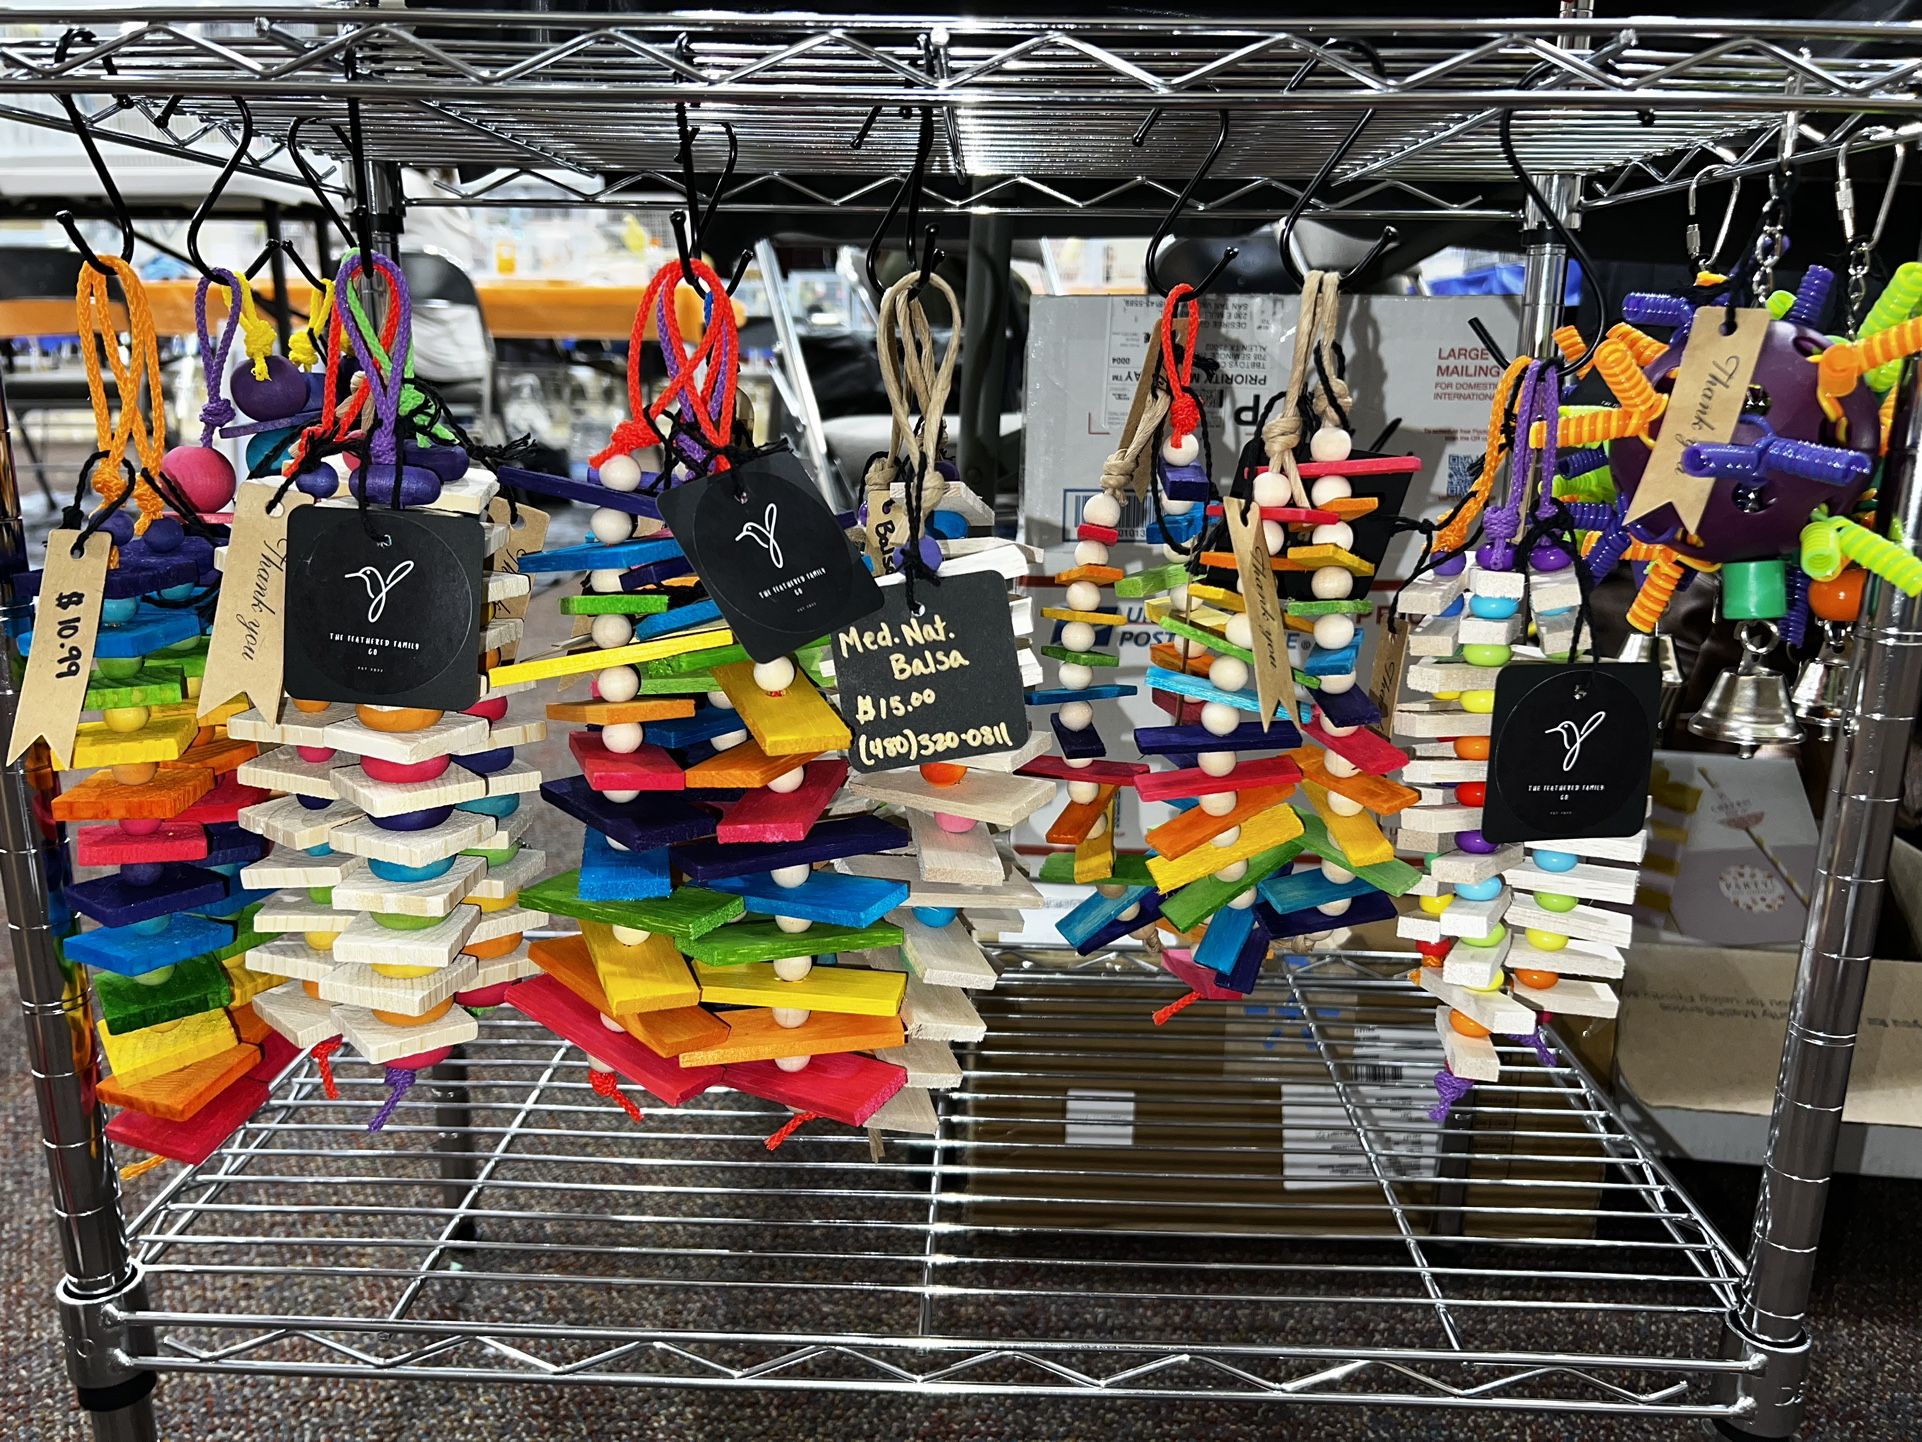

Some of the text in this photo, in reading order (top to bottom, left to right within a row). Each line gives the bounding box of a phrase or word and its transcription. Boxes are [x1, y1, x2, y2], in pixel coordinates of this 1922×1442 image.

[1438, 347, 1490, 361] LARGE
[1436, 364, 1501, 378] MAILING
[1203, 374, 1267, 386] PRIORITY
[1434, 382, 1454, 391] FOR
[1433, 391, 1497, 401] INTERNATIONA
[1692, 355, 1740, 432] Thank
[236, 538, 288, 661] Thank you
[1250, 546, 1277, 672] Thank you
[329, 632, 420, 650] THE FEATHERED FAMILY
[889, 649, 970, 681] Balsa
[1527, 784, 1541, 792] THE
[1543, 784, 1580, 792] FEATHERED
